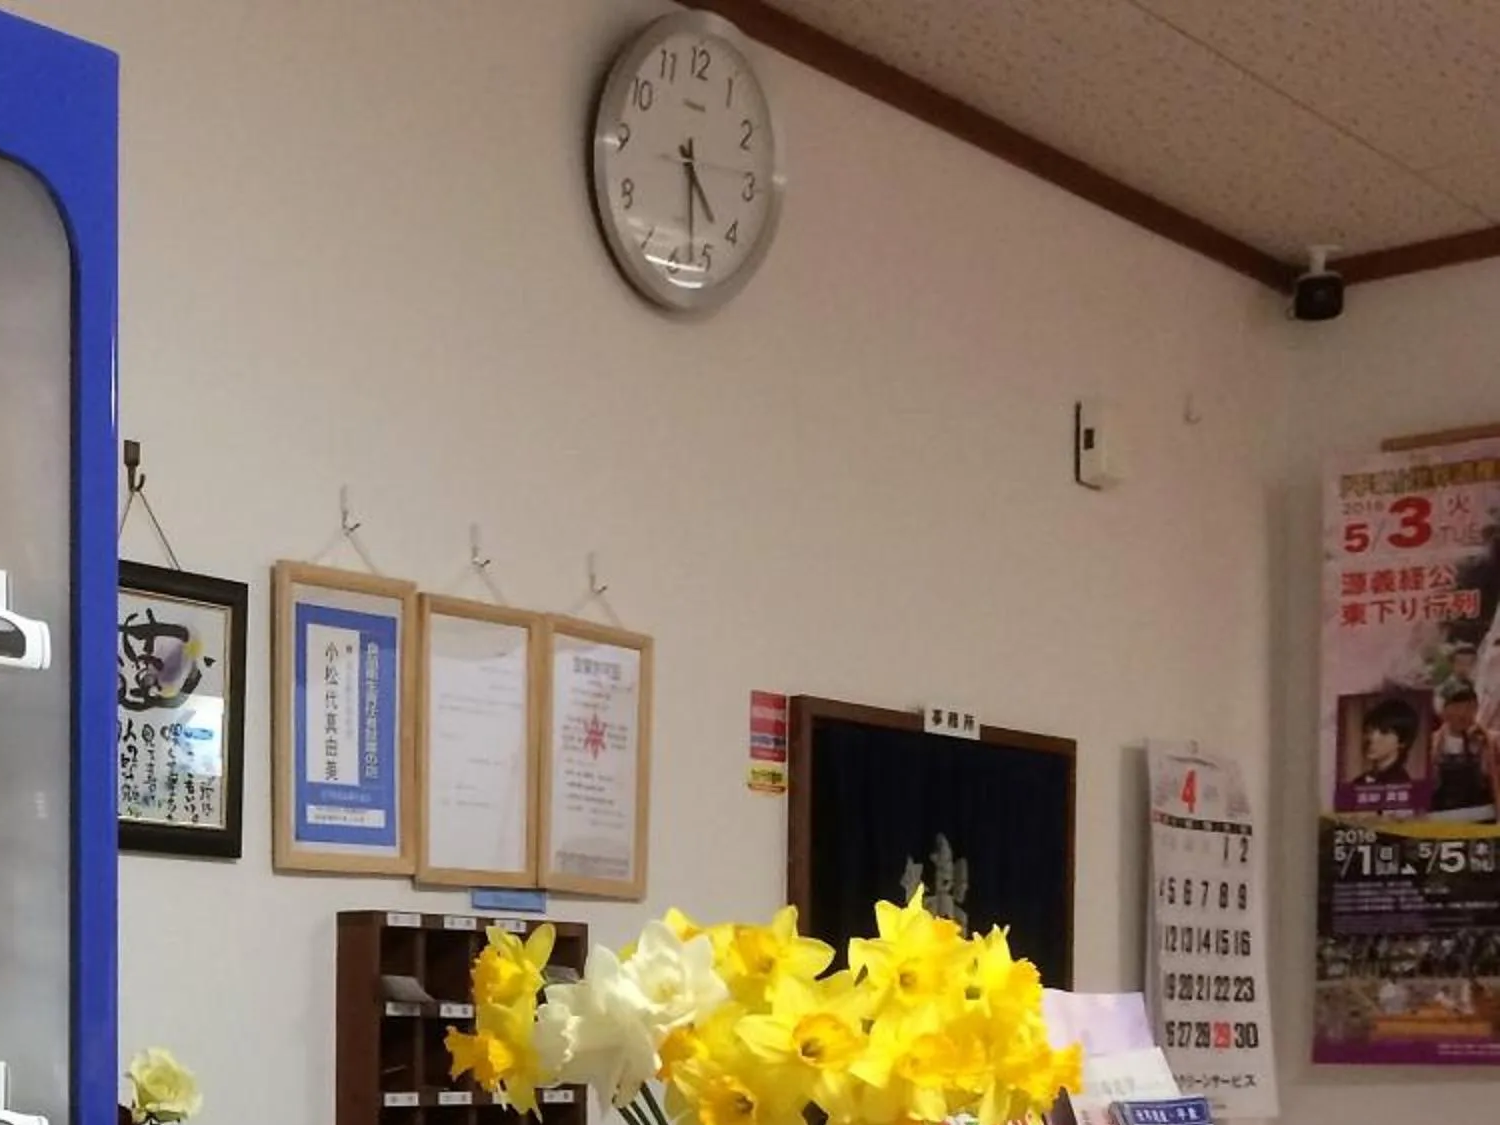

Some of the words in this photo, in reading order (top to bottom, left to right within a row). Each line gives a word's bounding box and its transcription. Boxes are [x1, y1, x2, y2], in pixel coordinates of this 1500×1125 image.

[660, 49, 677, 84] 11
[691, 46, 711, 81] 12
[632, 76, 653, 111] 10
[726, 77, 733, 108] 1
[618, 122, 631, 152] 9
[740, 119, 753, 151] 2
[621, 177, 635, 210] 8
[742, 171, 755, 202] 3
[725, 219, 738, 247] 4
[667, 247, 680, 274] 6
[700, 243, 713, 272] 5
[1182, 770, 1196, 813] 4
[1224, 836, 1229, 860] 1
[1240, 836, 1249, 862] 2
[1168, 877, 1176, 904] 5
[1184, 879, 1192, 906] 6
[1201, 881, 1209, 907] 7
[1219, 882, 1228, 908] 8
[1238, 883, 1247, 909] 9
[1165, 925, 1177, 952] 12
[1196, 929, 1211, 954] 14
[1216, 930, 1230, 956] 15
[1234, 931, 1251, 956] 16
[1196, 975, 1210, 1000] 21
[1214, 976, 1230, 1002] 22
[1234, 976, 1255, 1002] 23
[1178, 1021, 1192, 1048] 27
[1234, 1022, 1259, 1048] 30
